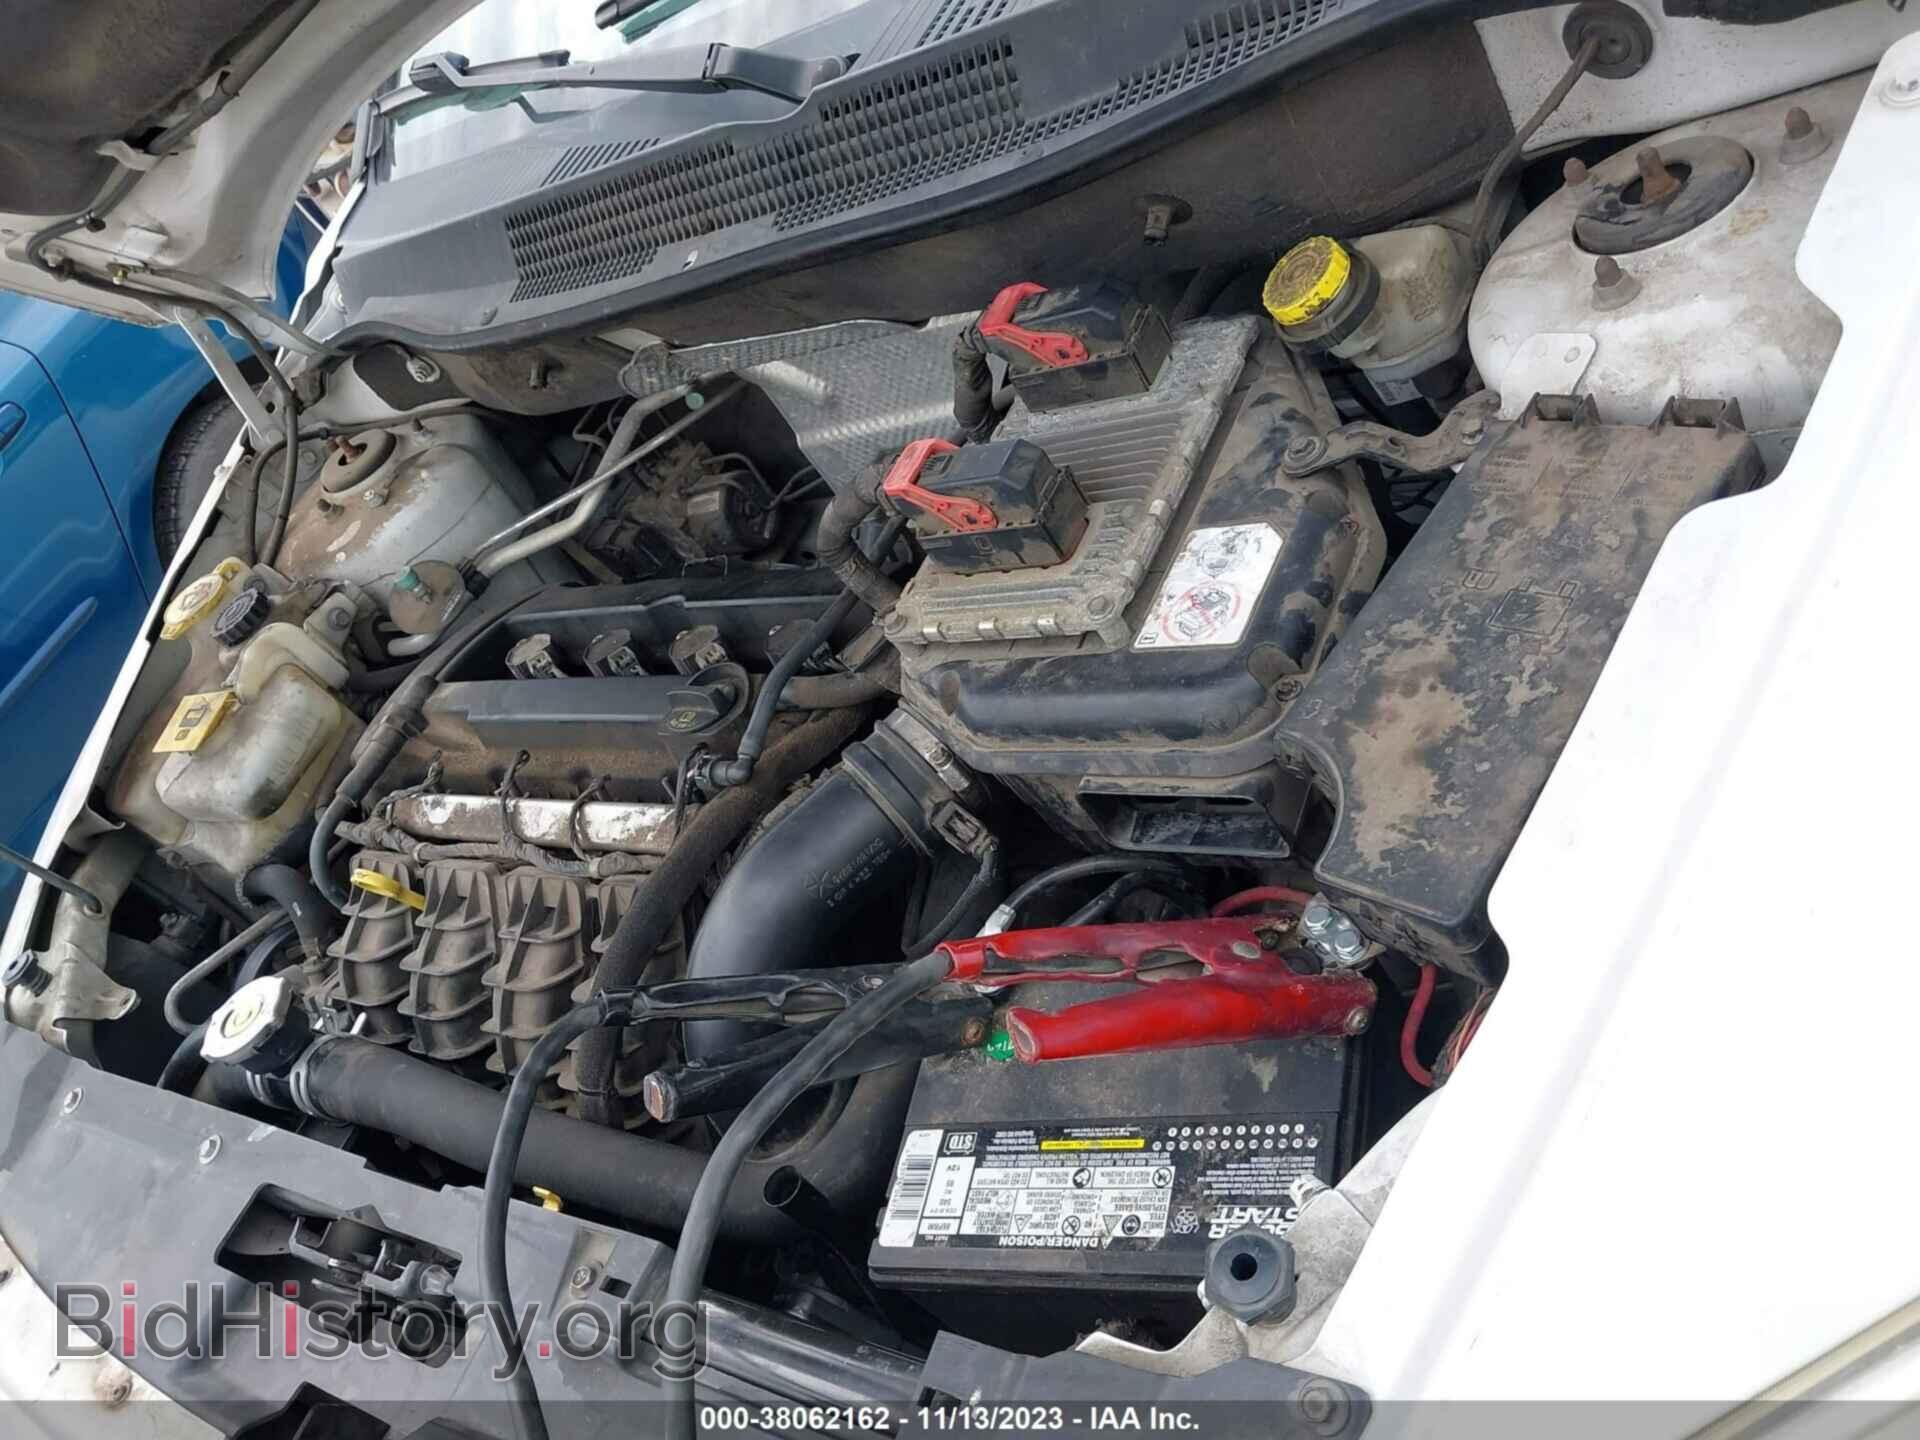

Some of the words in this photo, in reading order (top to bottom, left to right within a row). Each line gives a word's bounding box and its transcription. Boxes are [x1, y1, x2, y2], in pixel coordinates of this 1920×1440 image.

[948, 1134, 973, 1149] STD
[946, 1164, 960, 1172] 12V
[1209, 1208, 1298, 1223] START
[998, 1235, 1099, 1248] DANGER/POISON
